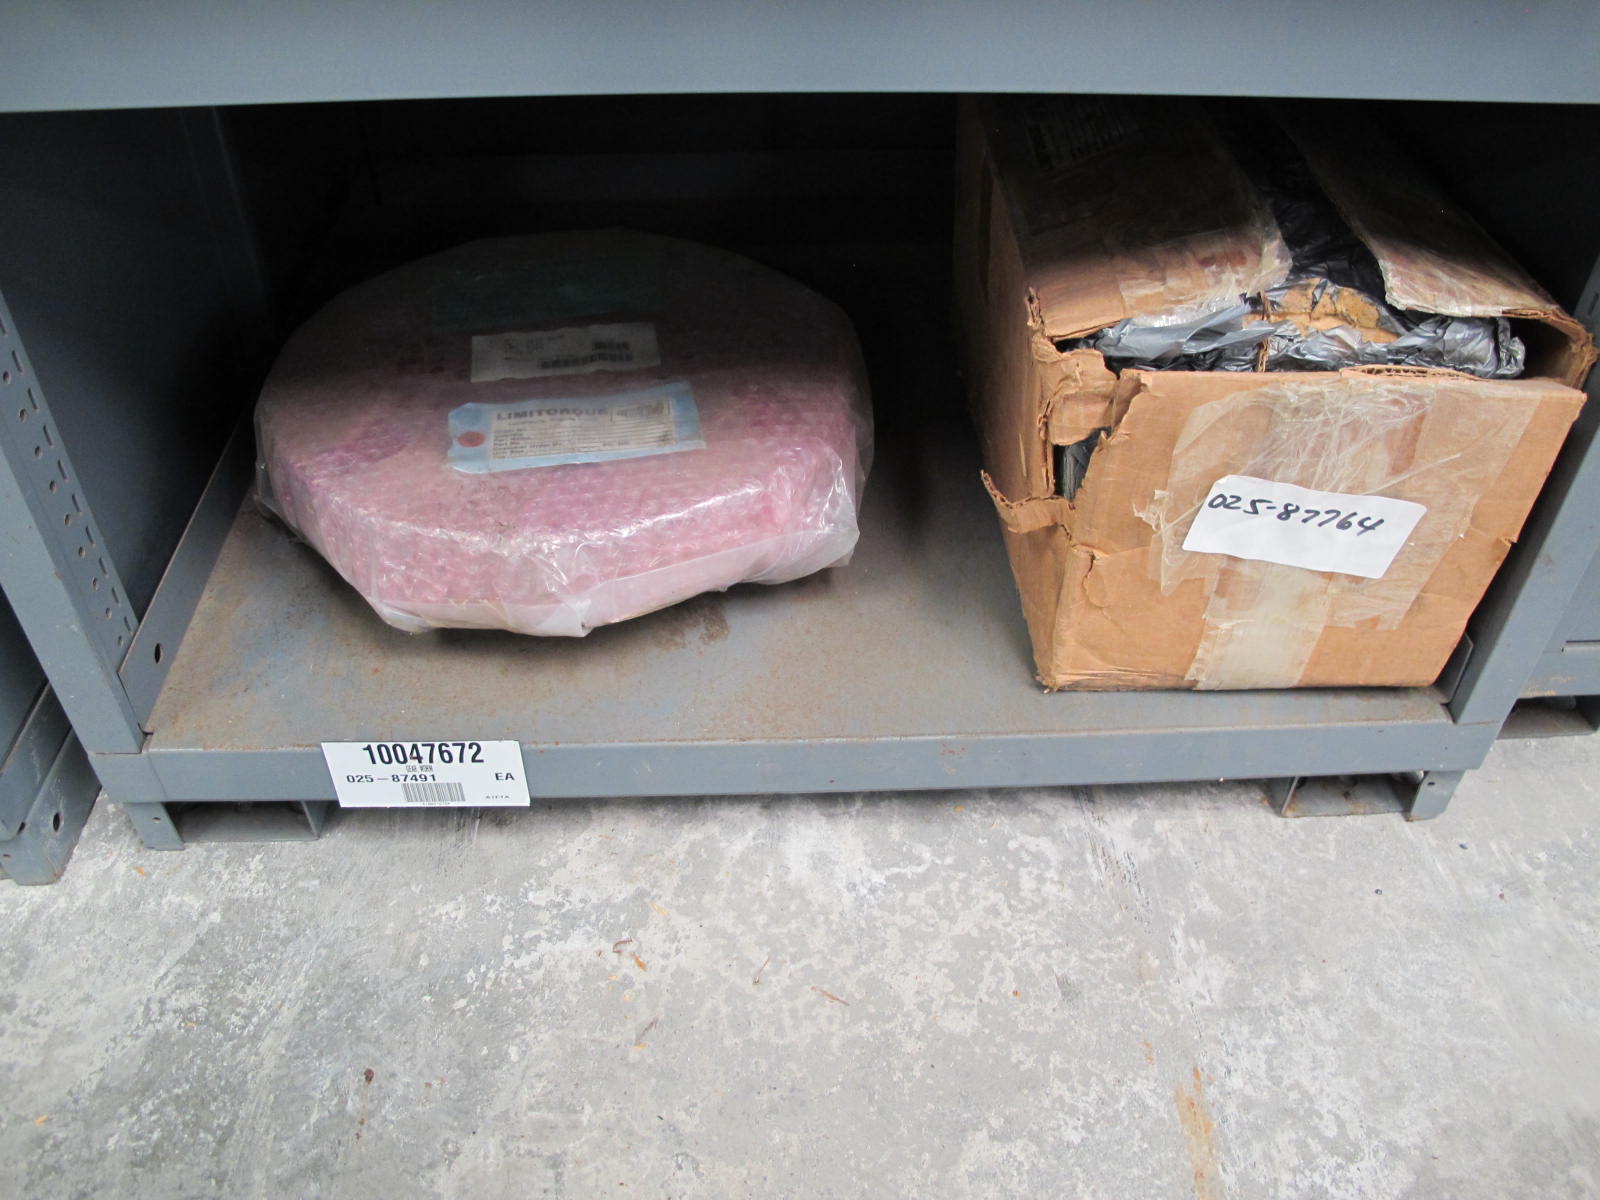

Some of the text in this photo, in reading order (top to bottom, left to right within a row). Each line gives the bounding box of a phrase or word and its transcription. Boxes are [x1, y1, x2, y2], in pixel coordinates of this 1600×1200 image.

[496, 406, 609, 421] LIMITORQUE
[1207, 493, 1385, 536] 025-87764
[362, 742, 485, 765] 10047672
[495, 772, 515, 781] EA
